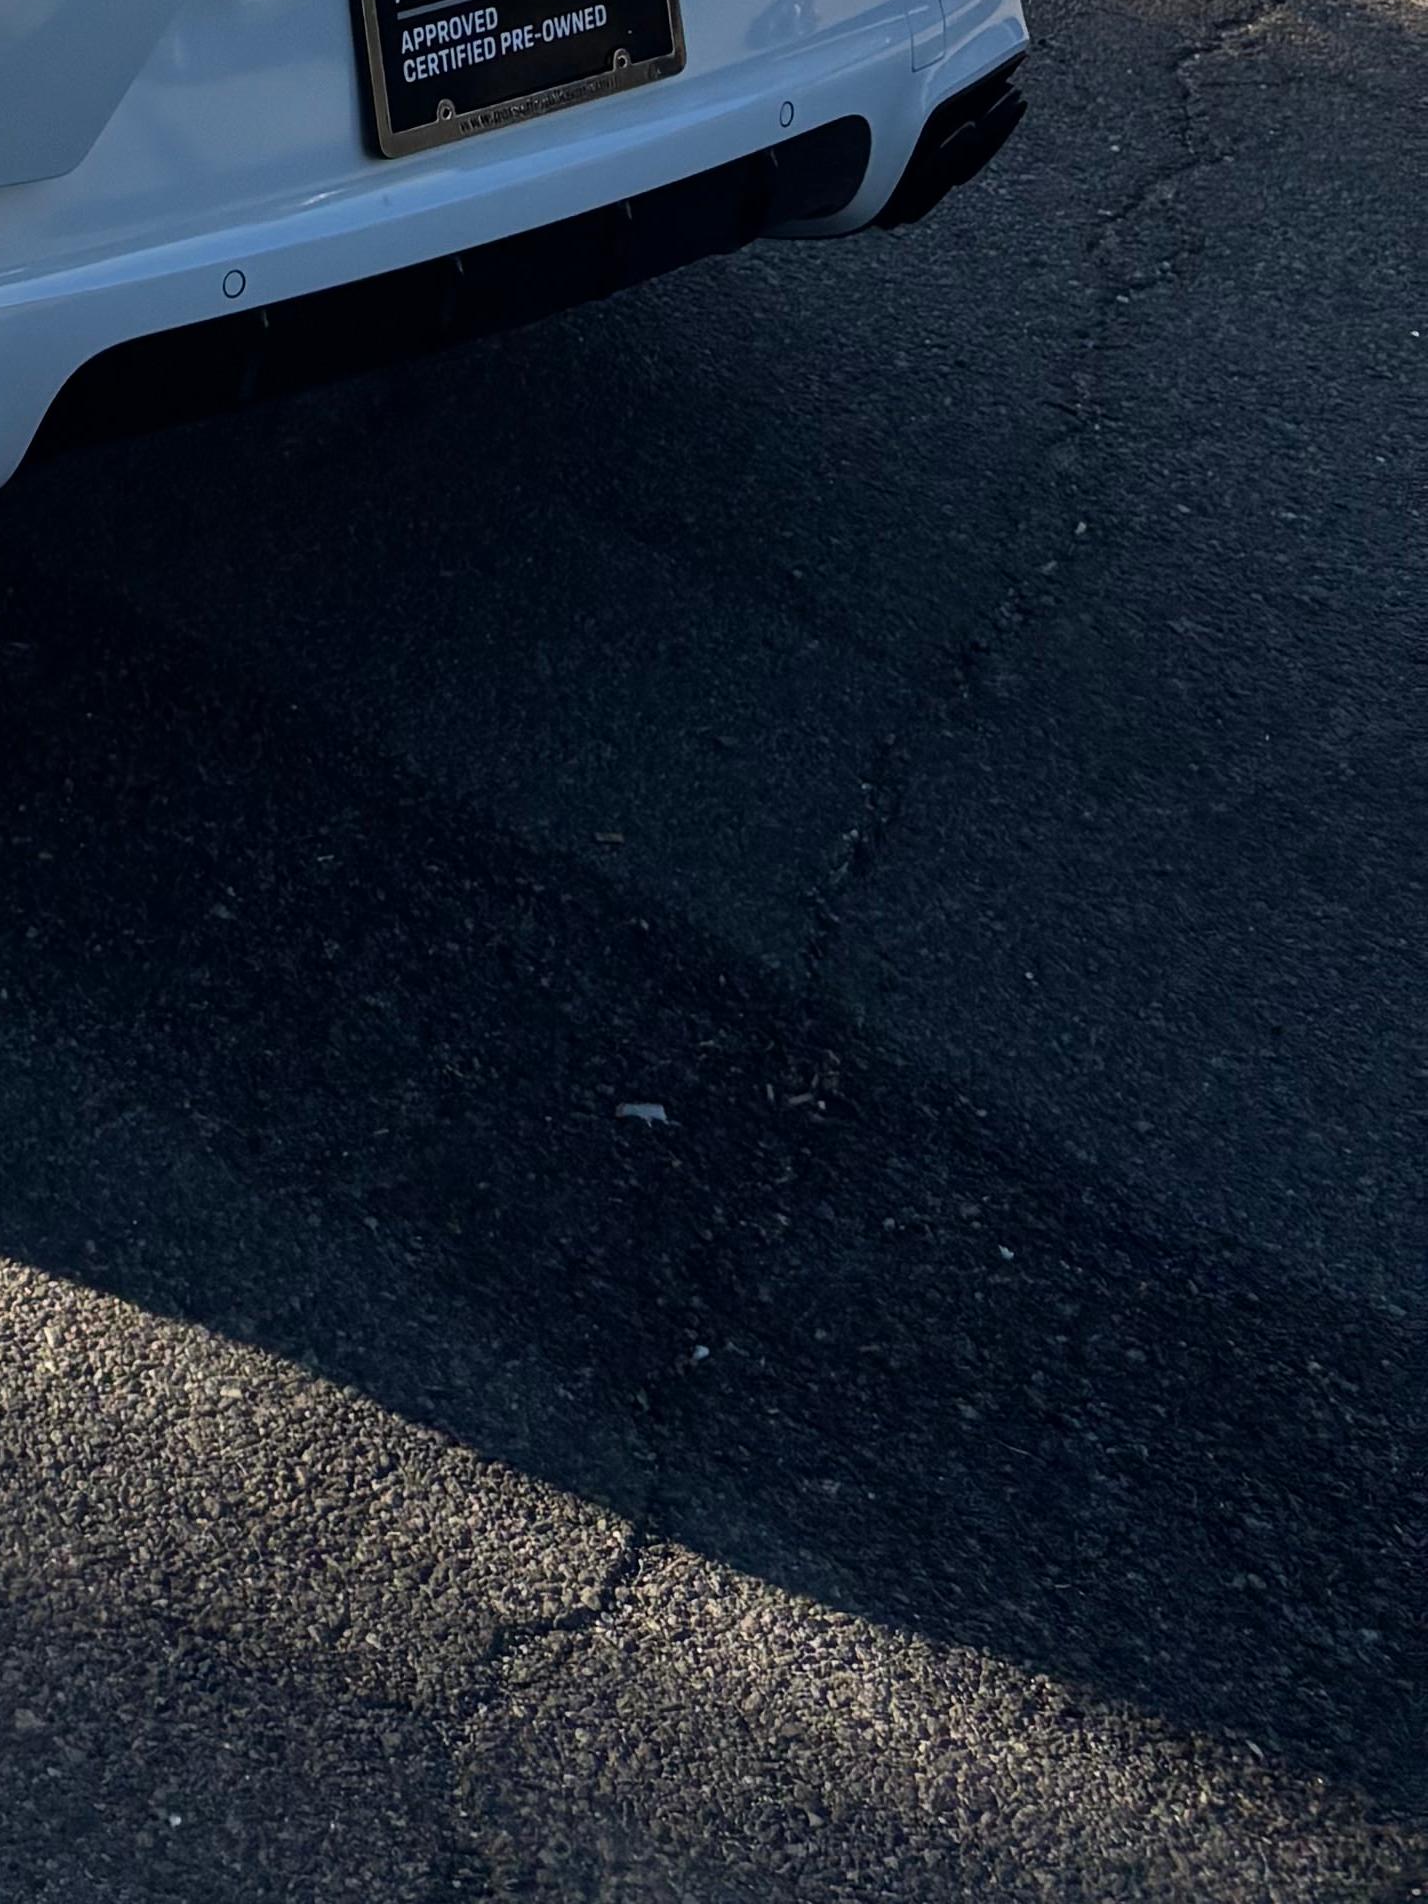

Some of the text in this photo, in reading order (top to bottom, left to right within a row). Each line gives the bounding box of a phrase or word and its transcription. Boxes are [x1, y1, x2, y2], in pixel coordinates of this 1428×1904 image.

[401, 7, 499, 54] APPROVED
[403, 4, 607, 83] CERTIFIED PRE-OWNED
